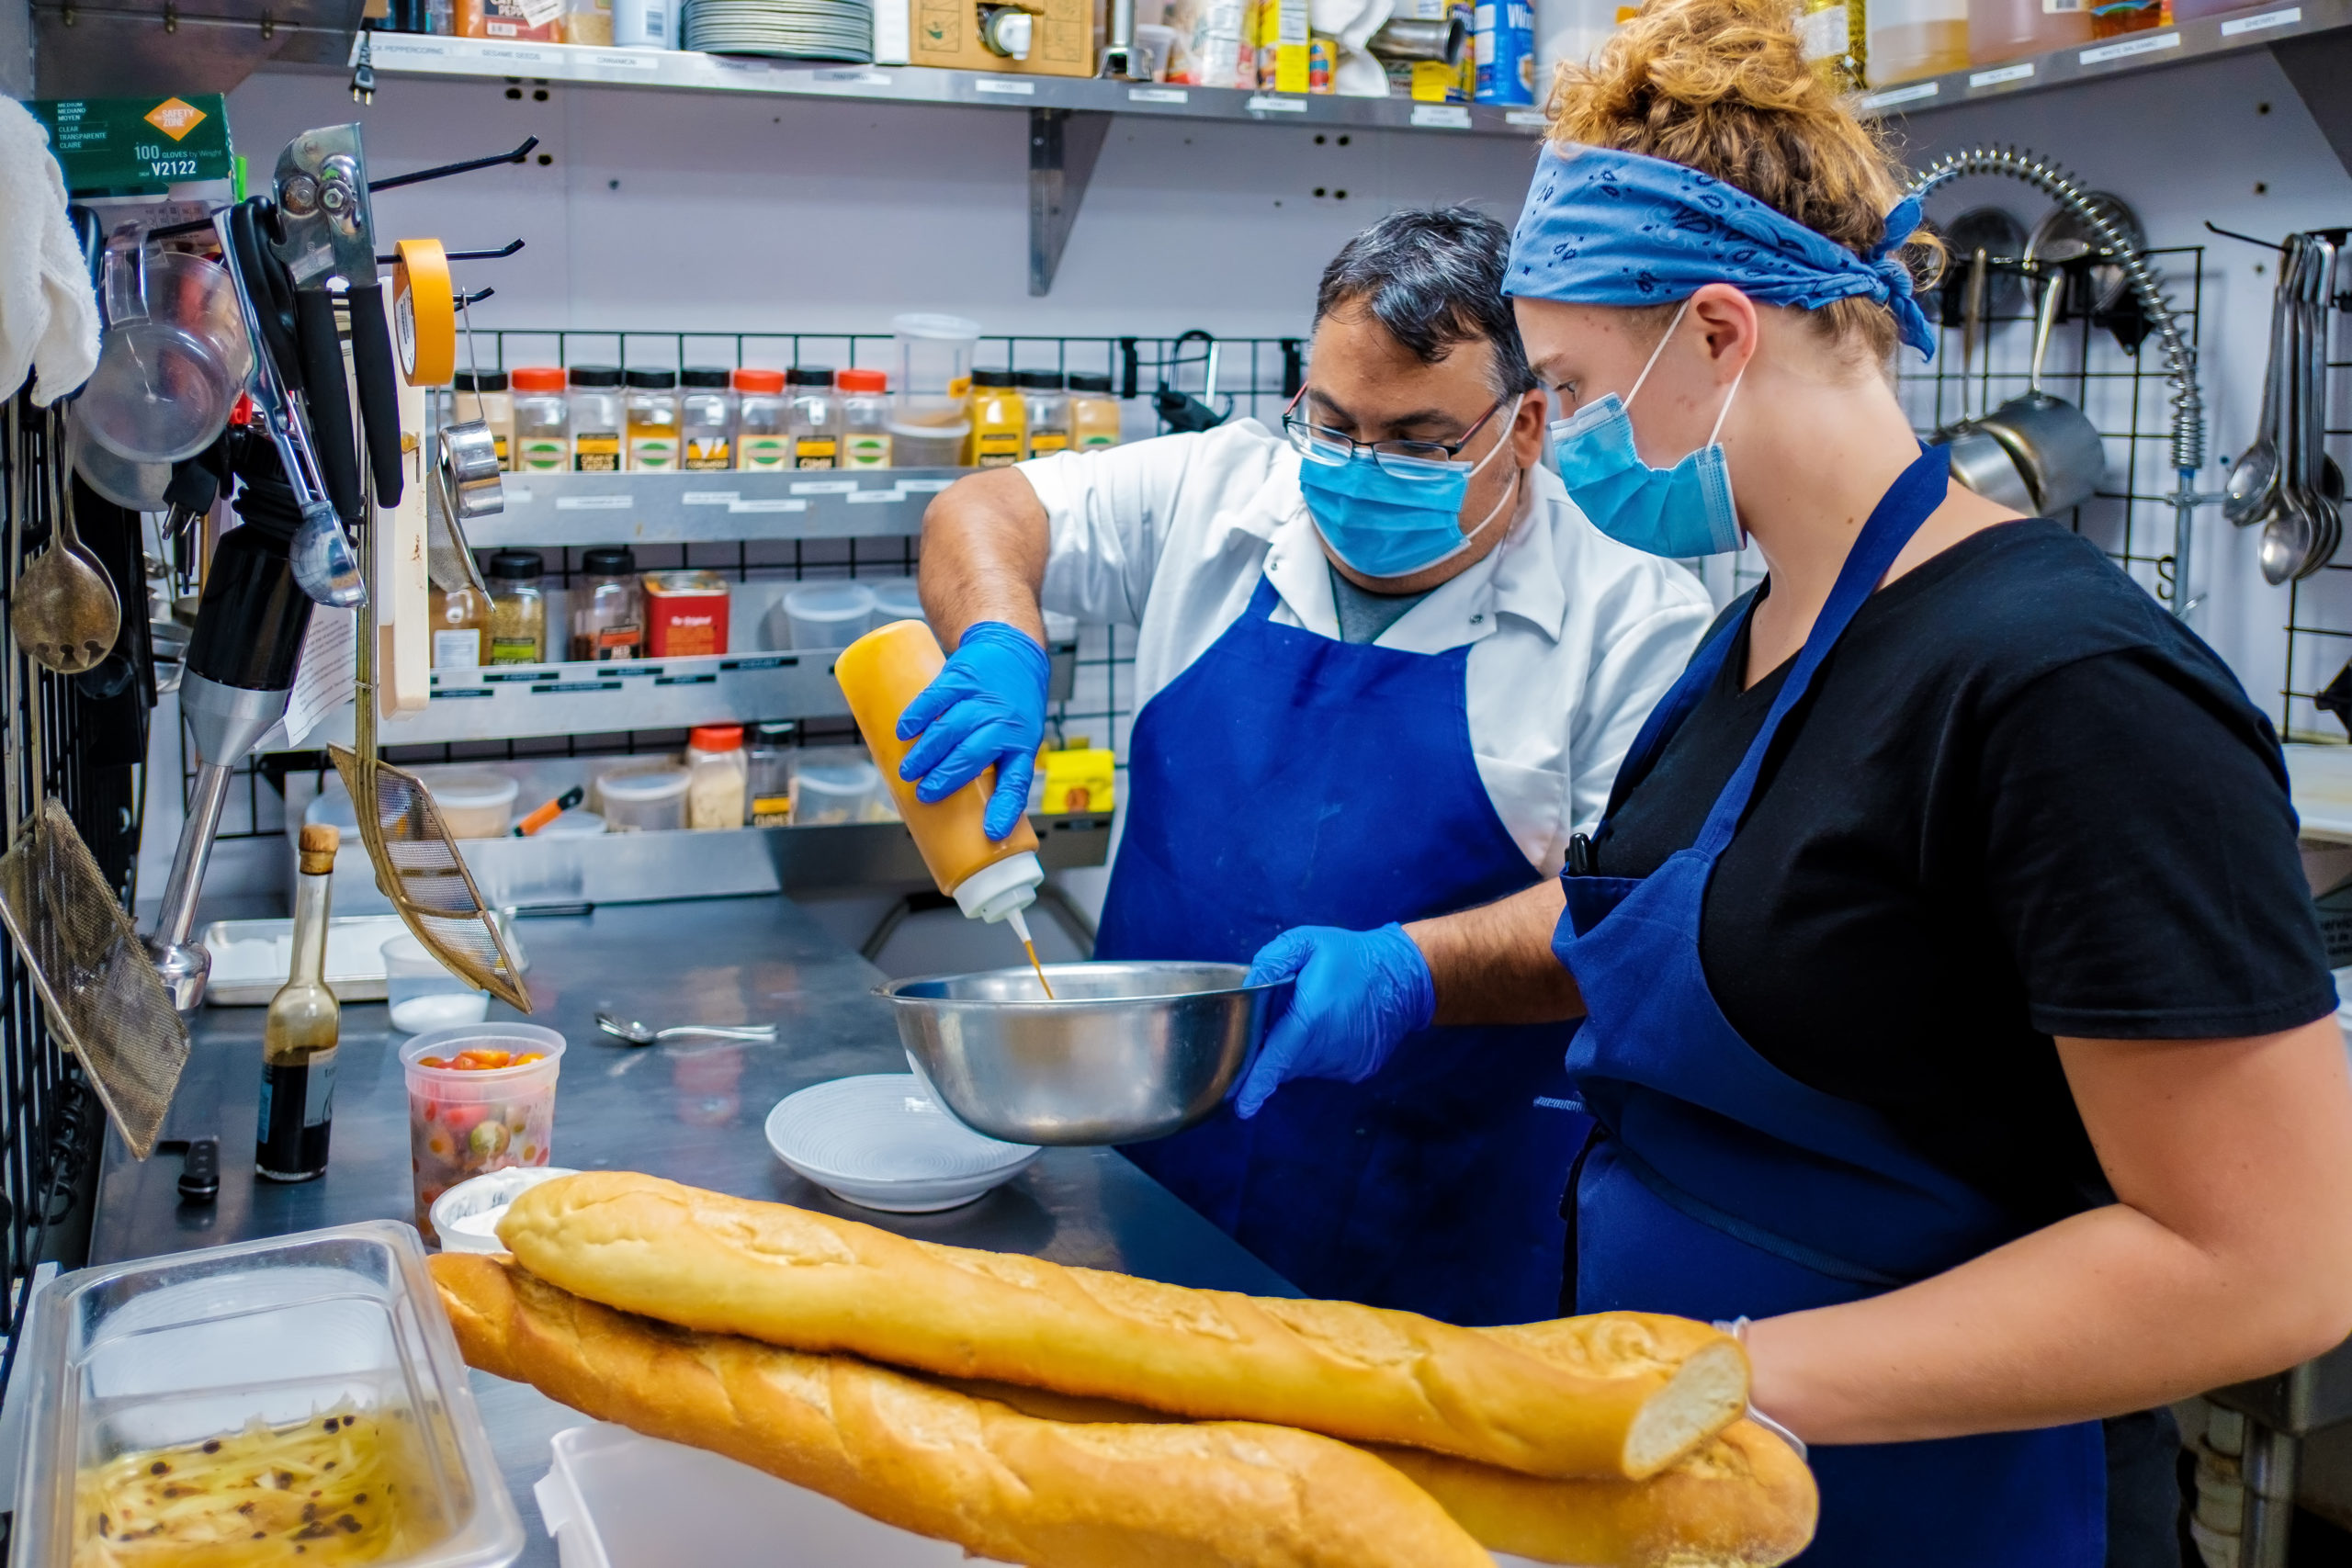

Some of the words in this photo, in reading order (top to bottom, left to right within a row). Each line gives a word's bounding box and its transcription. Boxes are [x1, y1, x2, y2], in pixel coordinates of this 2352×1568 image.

[162, 108, 194, 118] SAFETY
[163, 118, 185, 127] ZONE
[135, 145, 160, 160] 100
[198, 150, 222, 158] Weight
[151, 161, 197, 176] V2122
